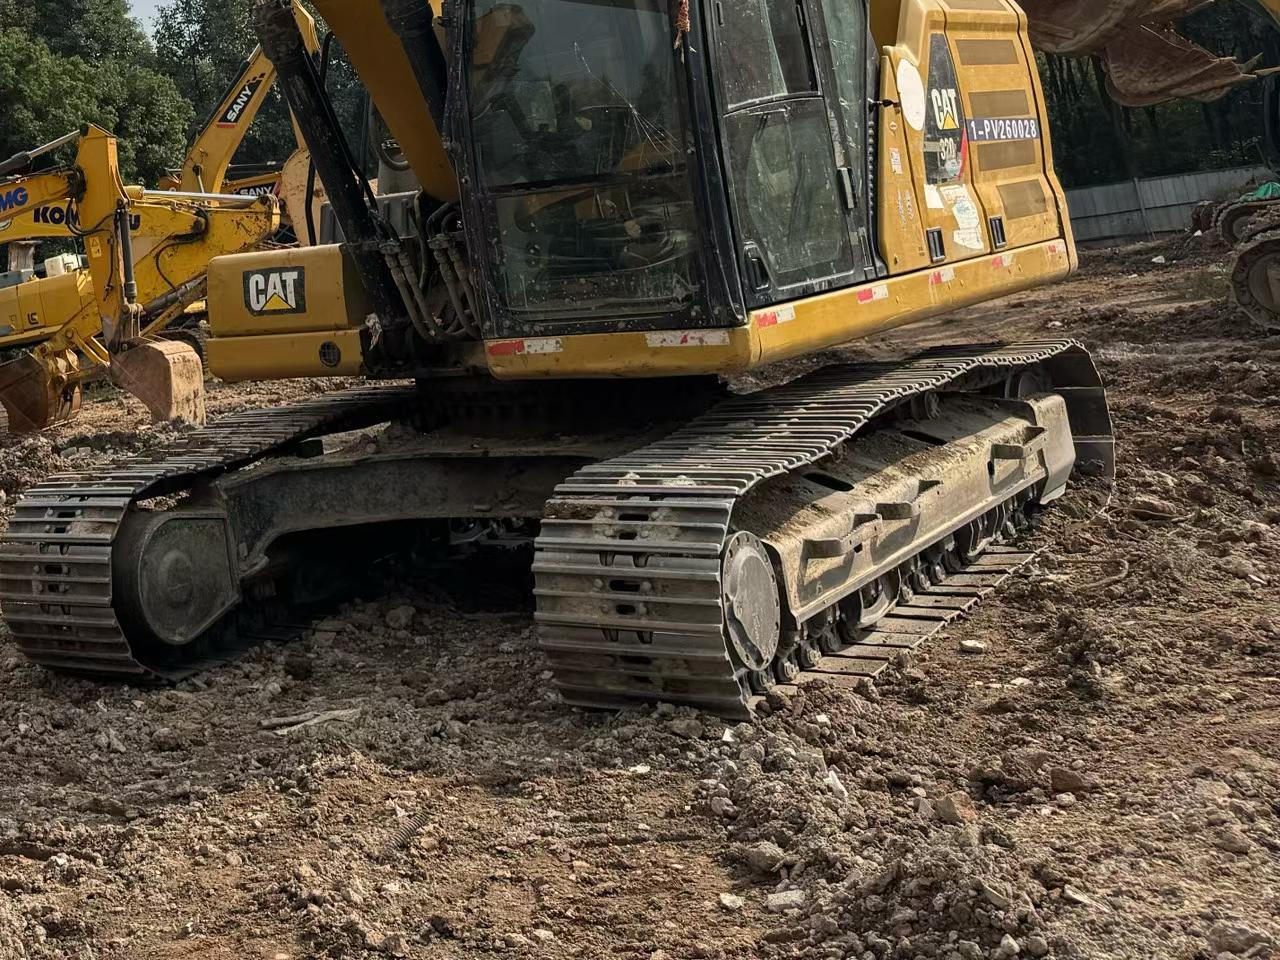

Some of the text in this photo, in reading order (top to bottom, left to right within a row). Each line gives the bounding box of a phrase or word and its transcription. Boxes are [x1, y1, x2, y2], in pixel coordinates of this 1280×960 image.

[226, 85, 253, 122] SANY
[931, 89, 960, 130] CAT
[970, 118, 1038, 140] 1-PV260028
[249, 271, 299, 311] CAT
